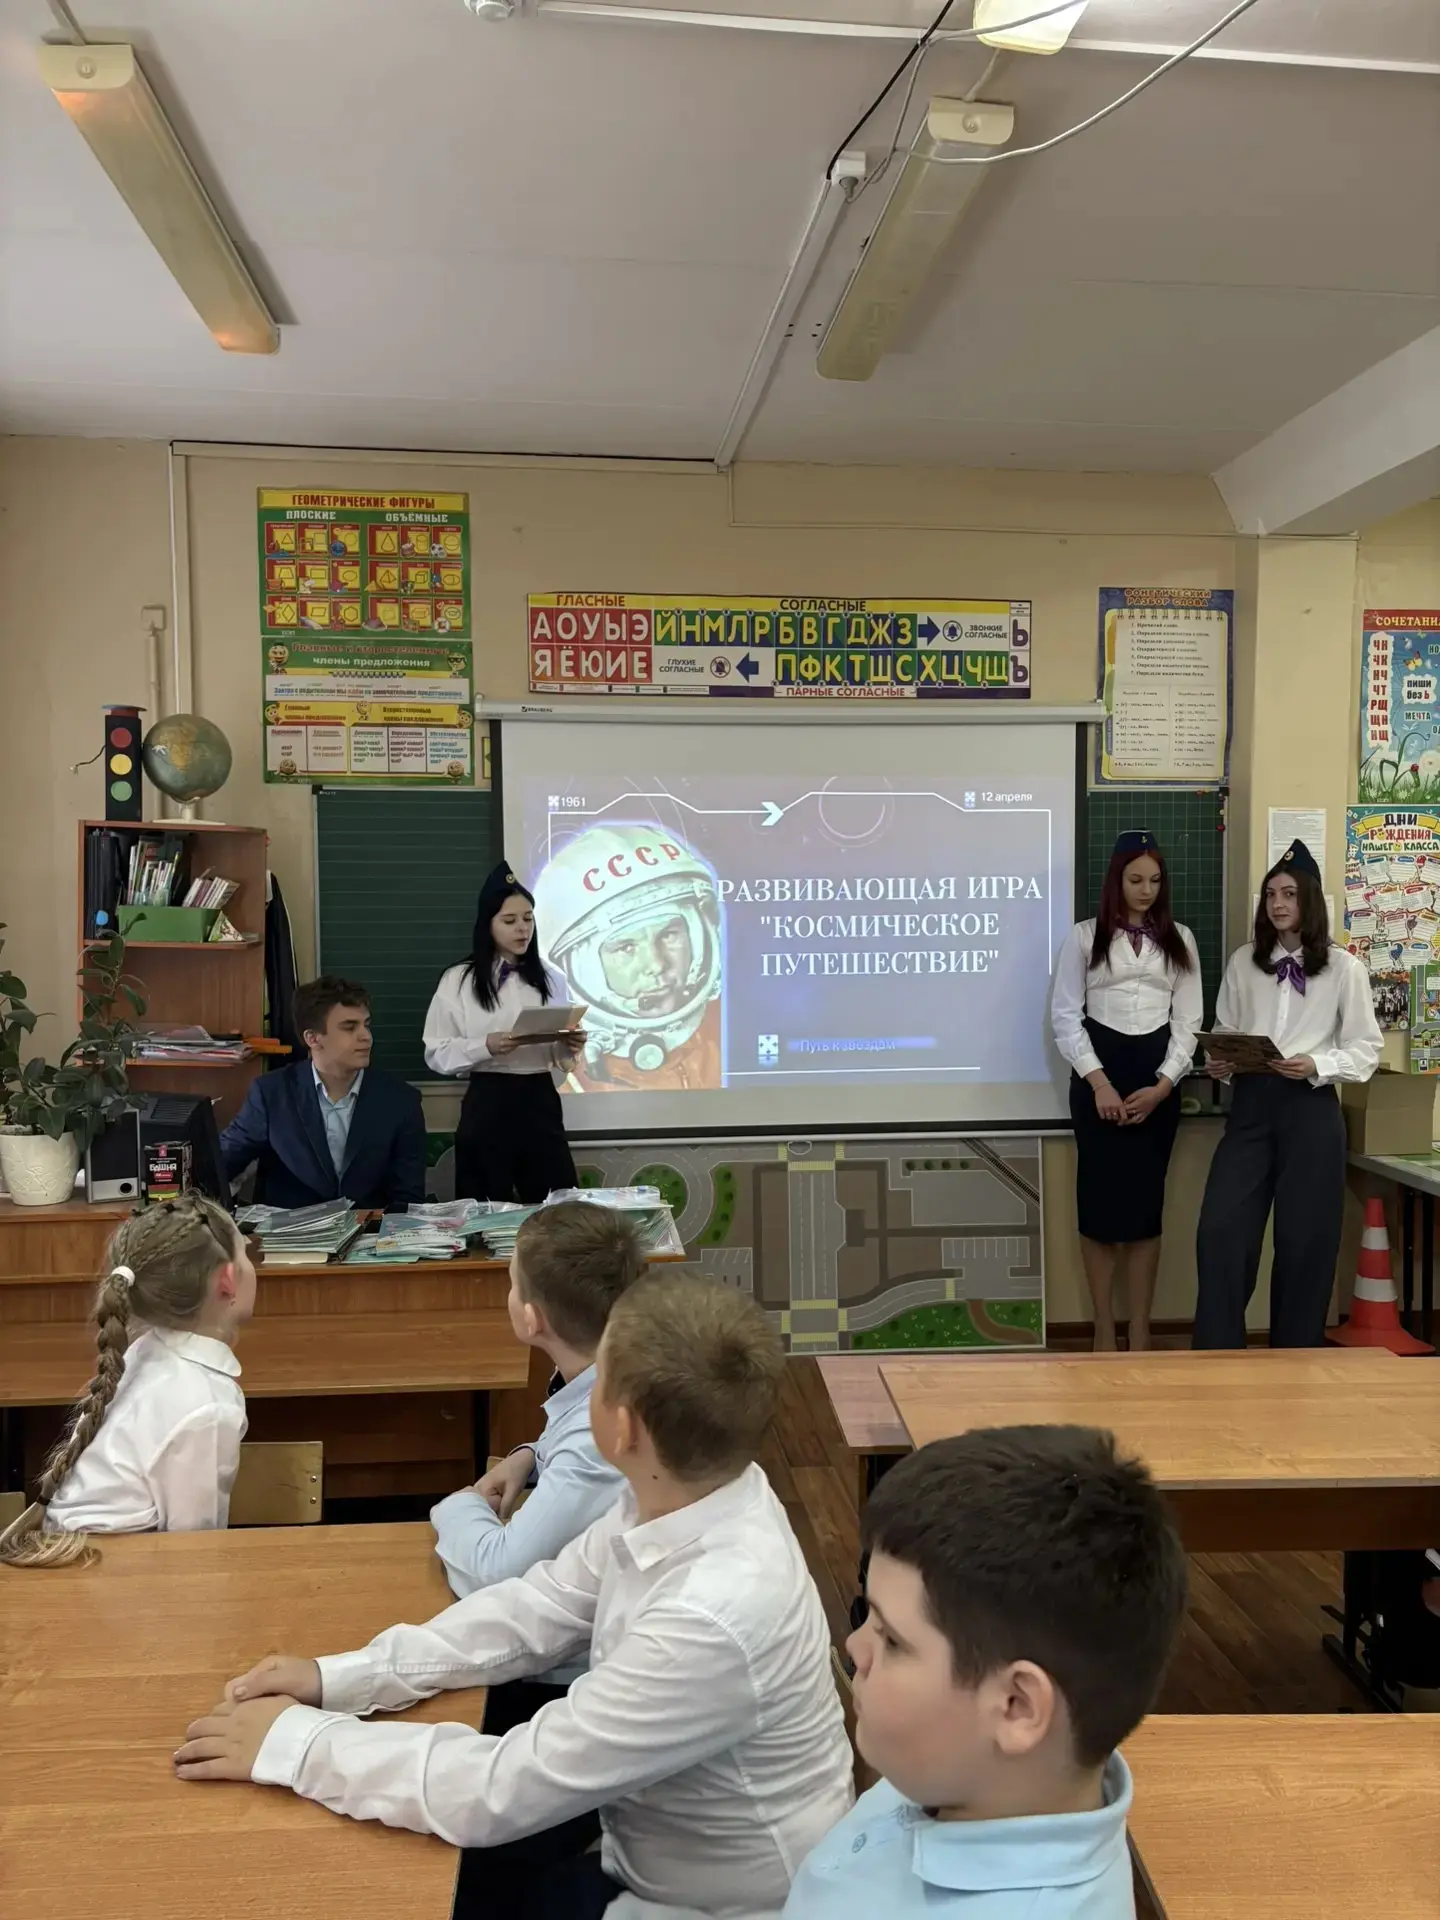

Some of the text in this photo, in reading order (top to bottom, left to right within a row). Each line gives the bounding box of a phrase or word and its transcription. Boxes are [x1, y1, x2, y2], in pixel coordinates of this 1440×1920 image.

[292, 495, 435, 509] ГЕОМЕТРИЧЕСКИЕ ФИГУРЫ
[286, 510, 336, 520] ПЛОСКИЕ
[556, 595, 625, 607] ГЛАСНЫЕ
[779, 598, 866, 612] СОГЛАСНЫЕ
[1376, 616, 1440, 627] СОЧЕТАНИ
[969, 624, 1003, 632] ЗВОНКИЕ
[1373, 640, 1388, 651] ЧН
[312, 656, 430, 667] члены предложения
[667, 658, 696, 666] ГЛУХИЕ
[1373, 655, 1388, 666] ЧК
[1373, 670, 1388, 680] НЧ
[786, 687, 905, 697] ПАРНЫЕ СОГЛАСНЫЕ
[1373, 685, 1387, 695] ЧТ
[1371, 700, 1388, 711] РЩ
[1370, 715, 1388, 726] ЩН
[1405, 712, 1430, 720] МЕЧТА
[1371, 730, 1389, 742] НЩ
[561, 796, 586, 807] 1961
[982, 791, 1033, 804] 12 апреля
[1384, 813, 1418, 828] ДНИ
[1404, 842, 1439, 851] КЛАССА
[583, 843, 681, 892] СССР
[718, 876, 1043, 904] РАЗВИВАЮЩАЯ ИГРА
[760, 913, 999, 938] "КОСМИЧЕСКОЕ
[761, 950, 999, 976] ПУТЕШЕСТВИЕ"
[801, 1040, 829, 1054] Путь
